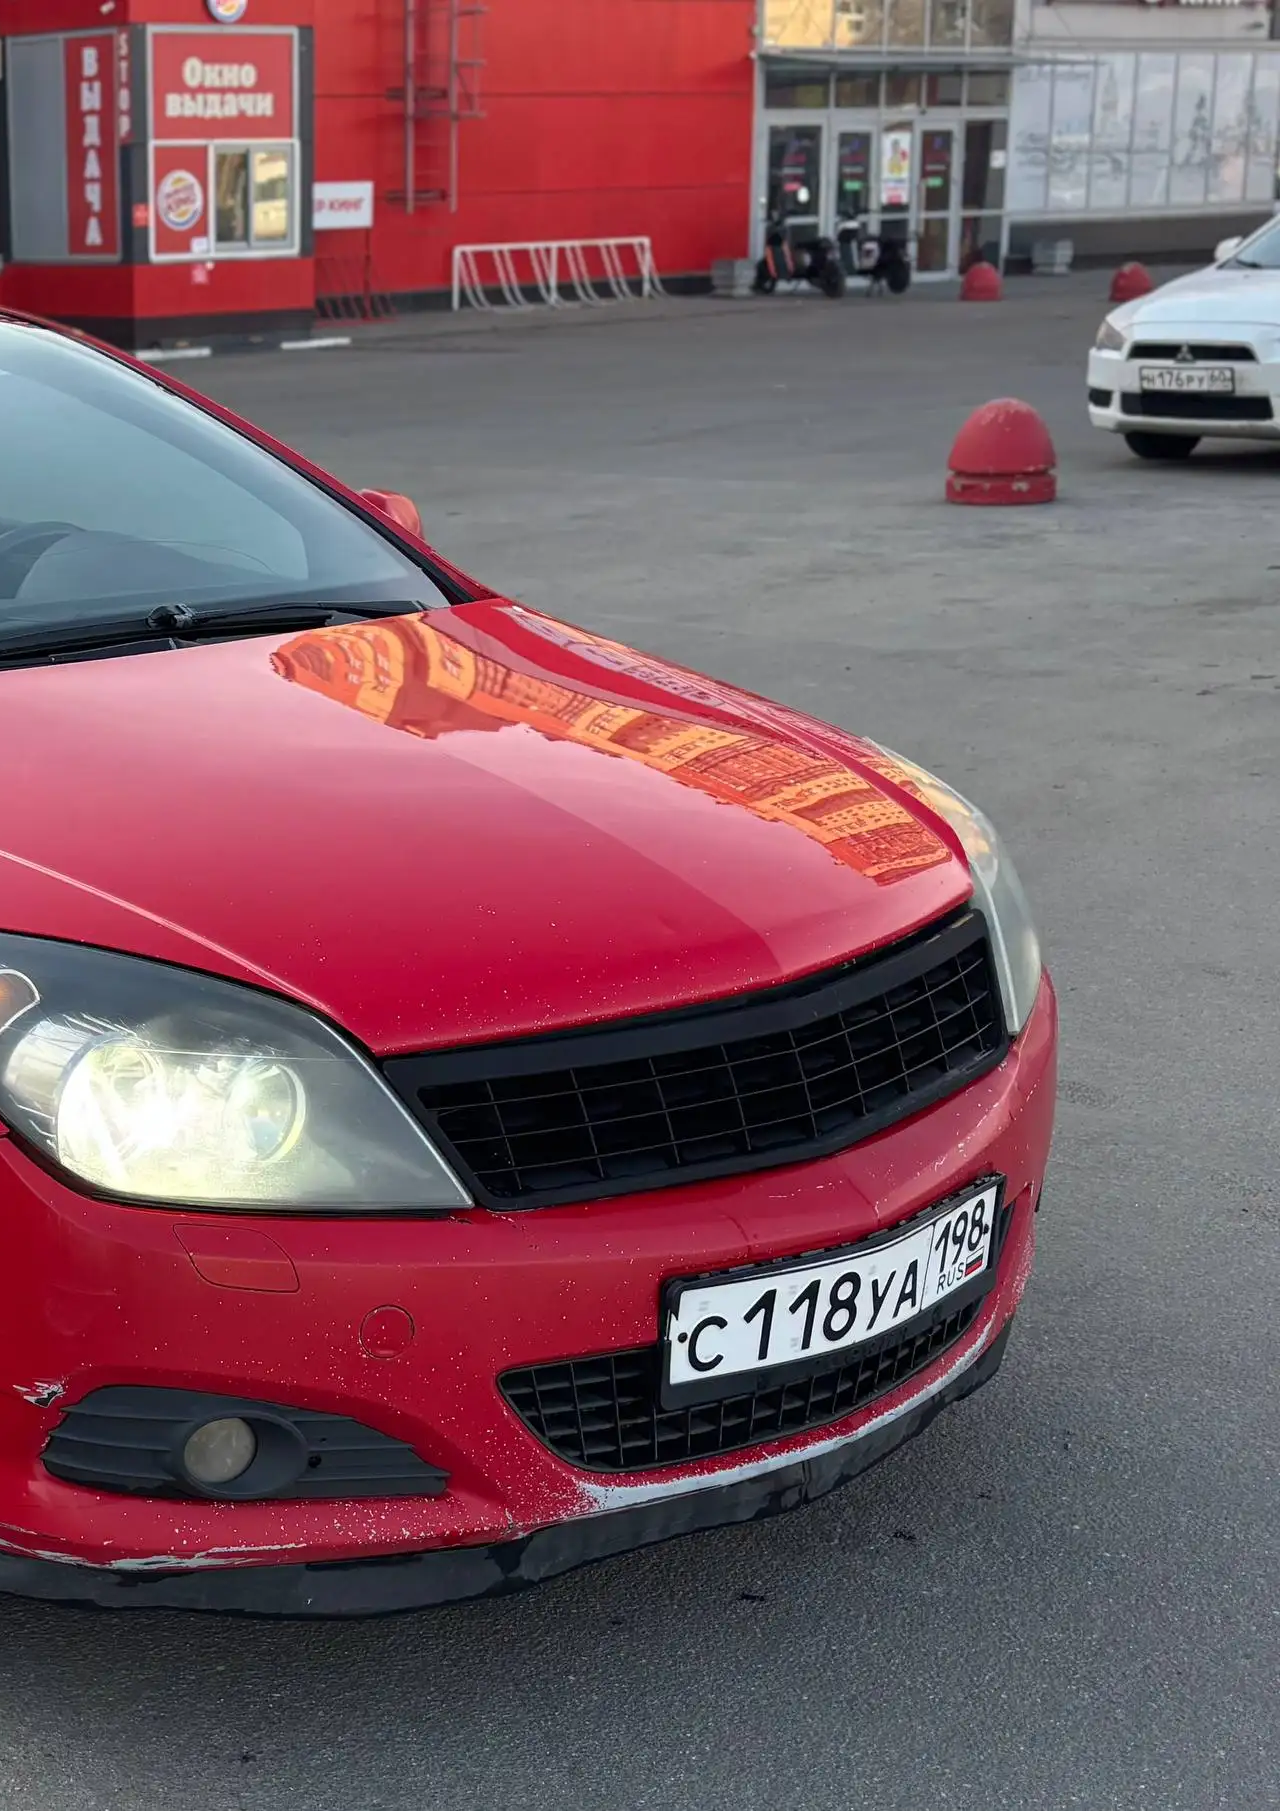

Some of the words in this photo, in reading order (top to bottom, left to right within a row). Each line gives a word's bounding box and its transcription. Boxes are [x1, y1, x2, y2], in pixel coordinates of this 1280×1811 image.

[182, 56, 257, 88] Окно
[165, 92, 274, 119] выдачи
[80, 46, 102, 246] ВЫДАЧА
[686, 1257, 920, 1372] С118УА
[934, 1198, 987, 1272] 198
[936, 1265, 965, 1296] RUS
